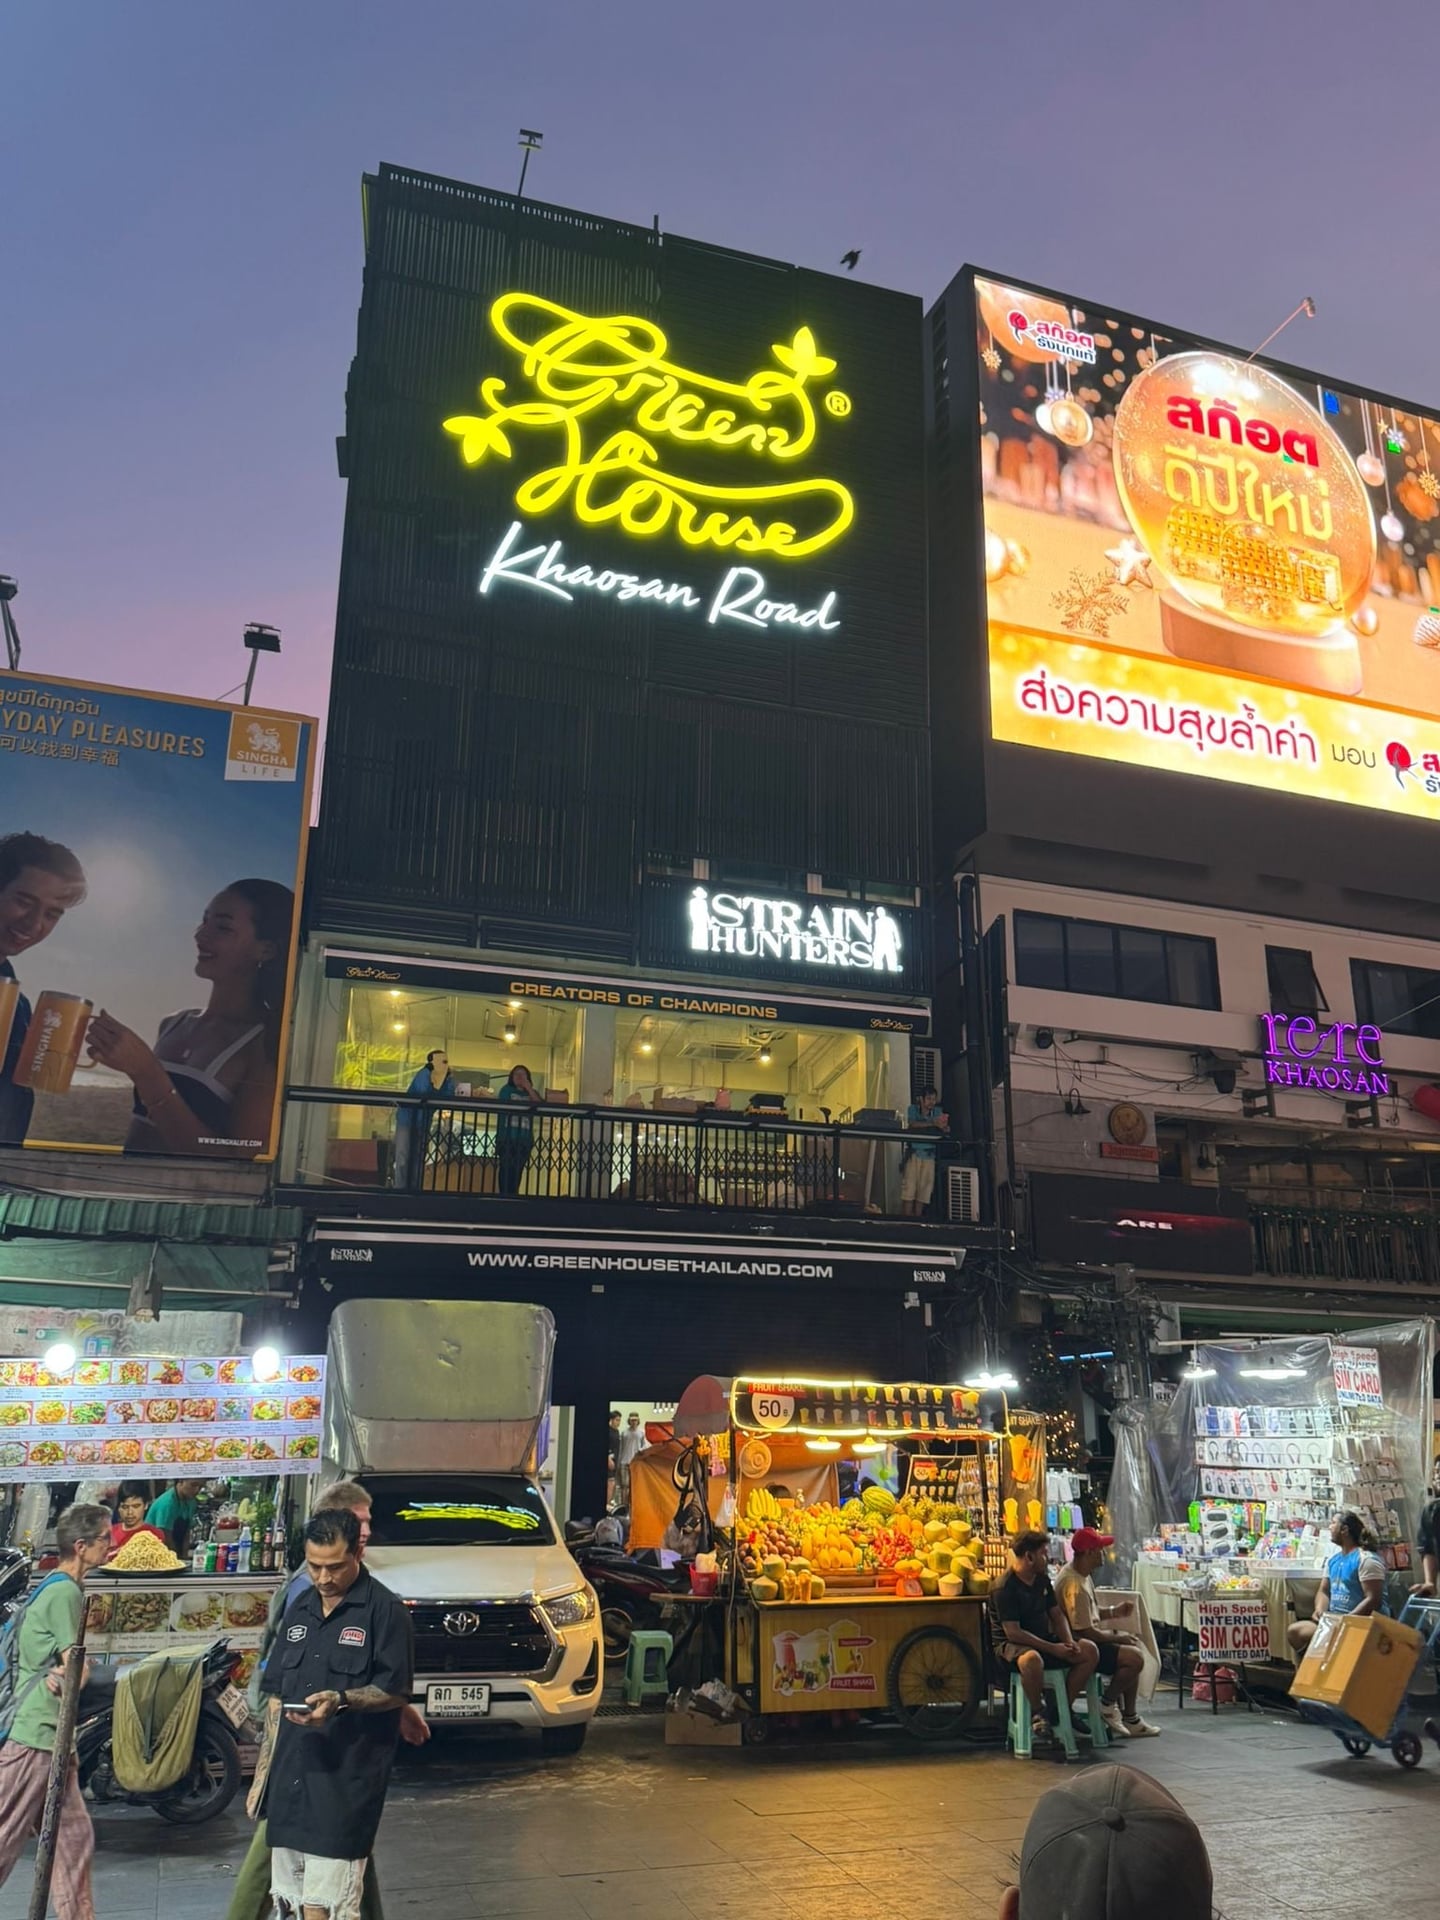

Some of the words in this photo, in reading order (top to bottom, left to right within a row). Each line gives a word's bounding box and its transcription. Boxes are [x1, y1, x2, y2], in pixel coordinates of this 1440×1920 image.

[490, 291, 836, 459] Green
[500, 428, 854, 557] House
[1164, 443, 1334, 542] ดีปีใหม่
[478, 520, 701, 608] Khaosan
[706, 566, 842, 631] Road
[1020, 670, 1318, 764] ส่งความสุขล้ำค่า
[1330, 743, 1377, 769] มอบ
[71, 719, 206, 759] PLEASURES
[236, 750, 289, 767] SINGHA
[241, 764, 281, 778] LIFE
[711, 893, 874, 943] STRAIN
[711, 927, 874, 968] HUNTERS
[509, 982, 621, 1004] CREATORS
[627, 993, 654, 1006] OF
[660, 996, 778, 1019] CHAMPIONS
[31, 1027, 56, 1073] SINGHA
[1266, 1059, 1390, 1094] KHAOSAN
[467, 1252, 834, 1279] WWW.GREENHOUSETHAILAND.COM
[1353, 1371, 1380, 1394] CARD
[758, 1399, 781, 1418] 50
[1199, 1604, 1228, 1615] High
[1231, 1603, 1268, 1615] Speed
[1199, 1614, 1268, 1625] INTERNET
[1200, 1626, 1227, 1649] SIM
[1231, 1626, 1269, 1648] CARD
[1201, 1649, 1248, 1659] UNLIMITED
[1250, 1648, 1270, 1658] DATA
[461, 1687, 484, 1700] 545
